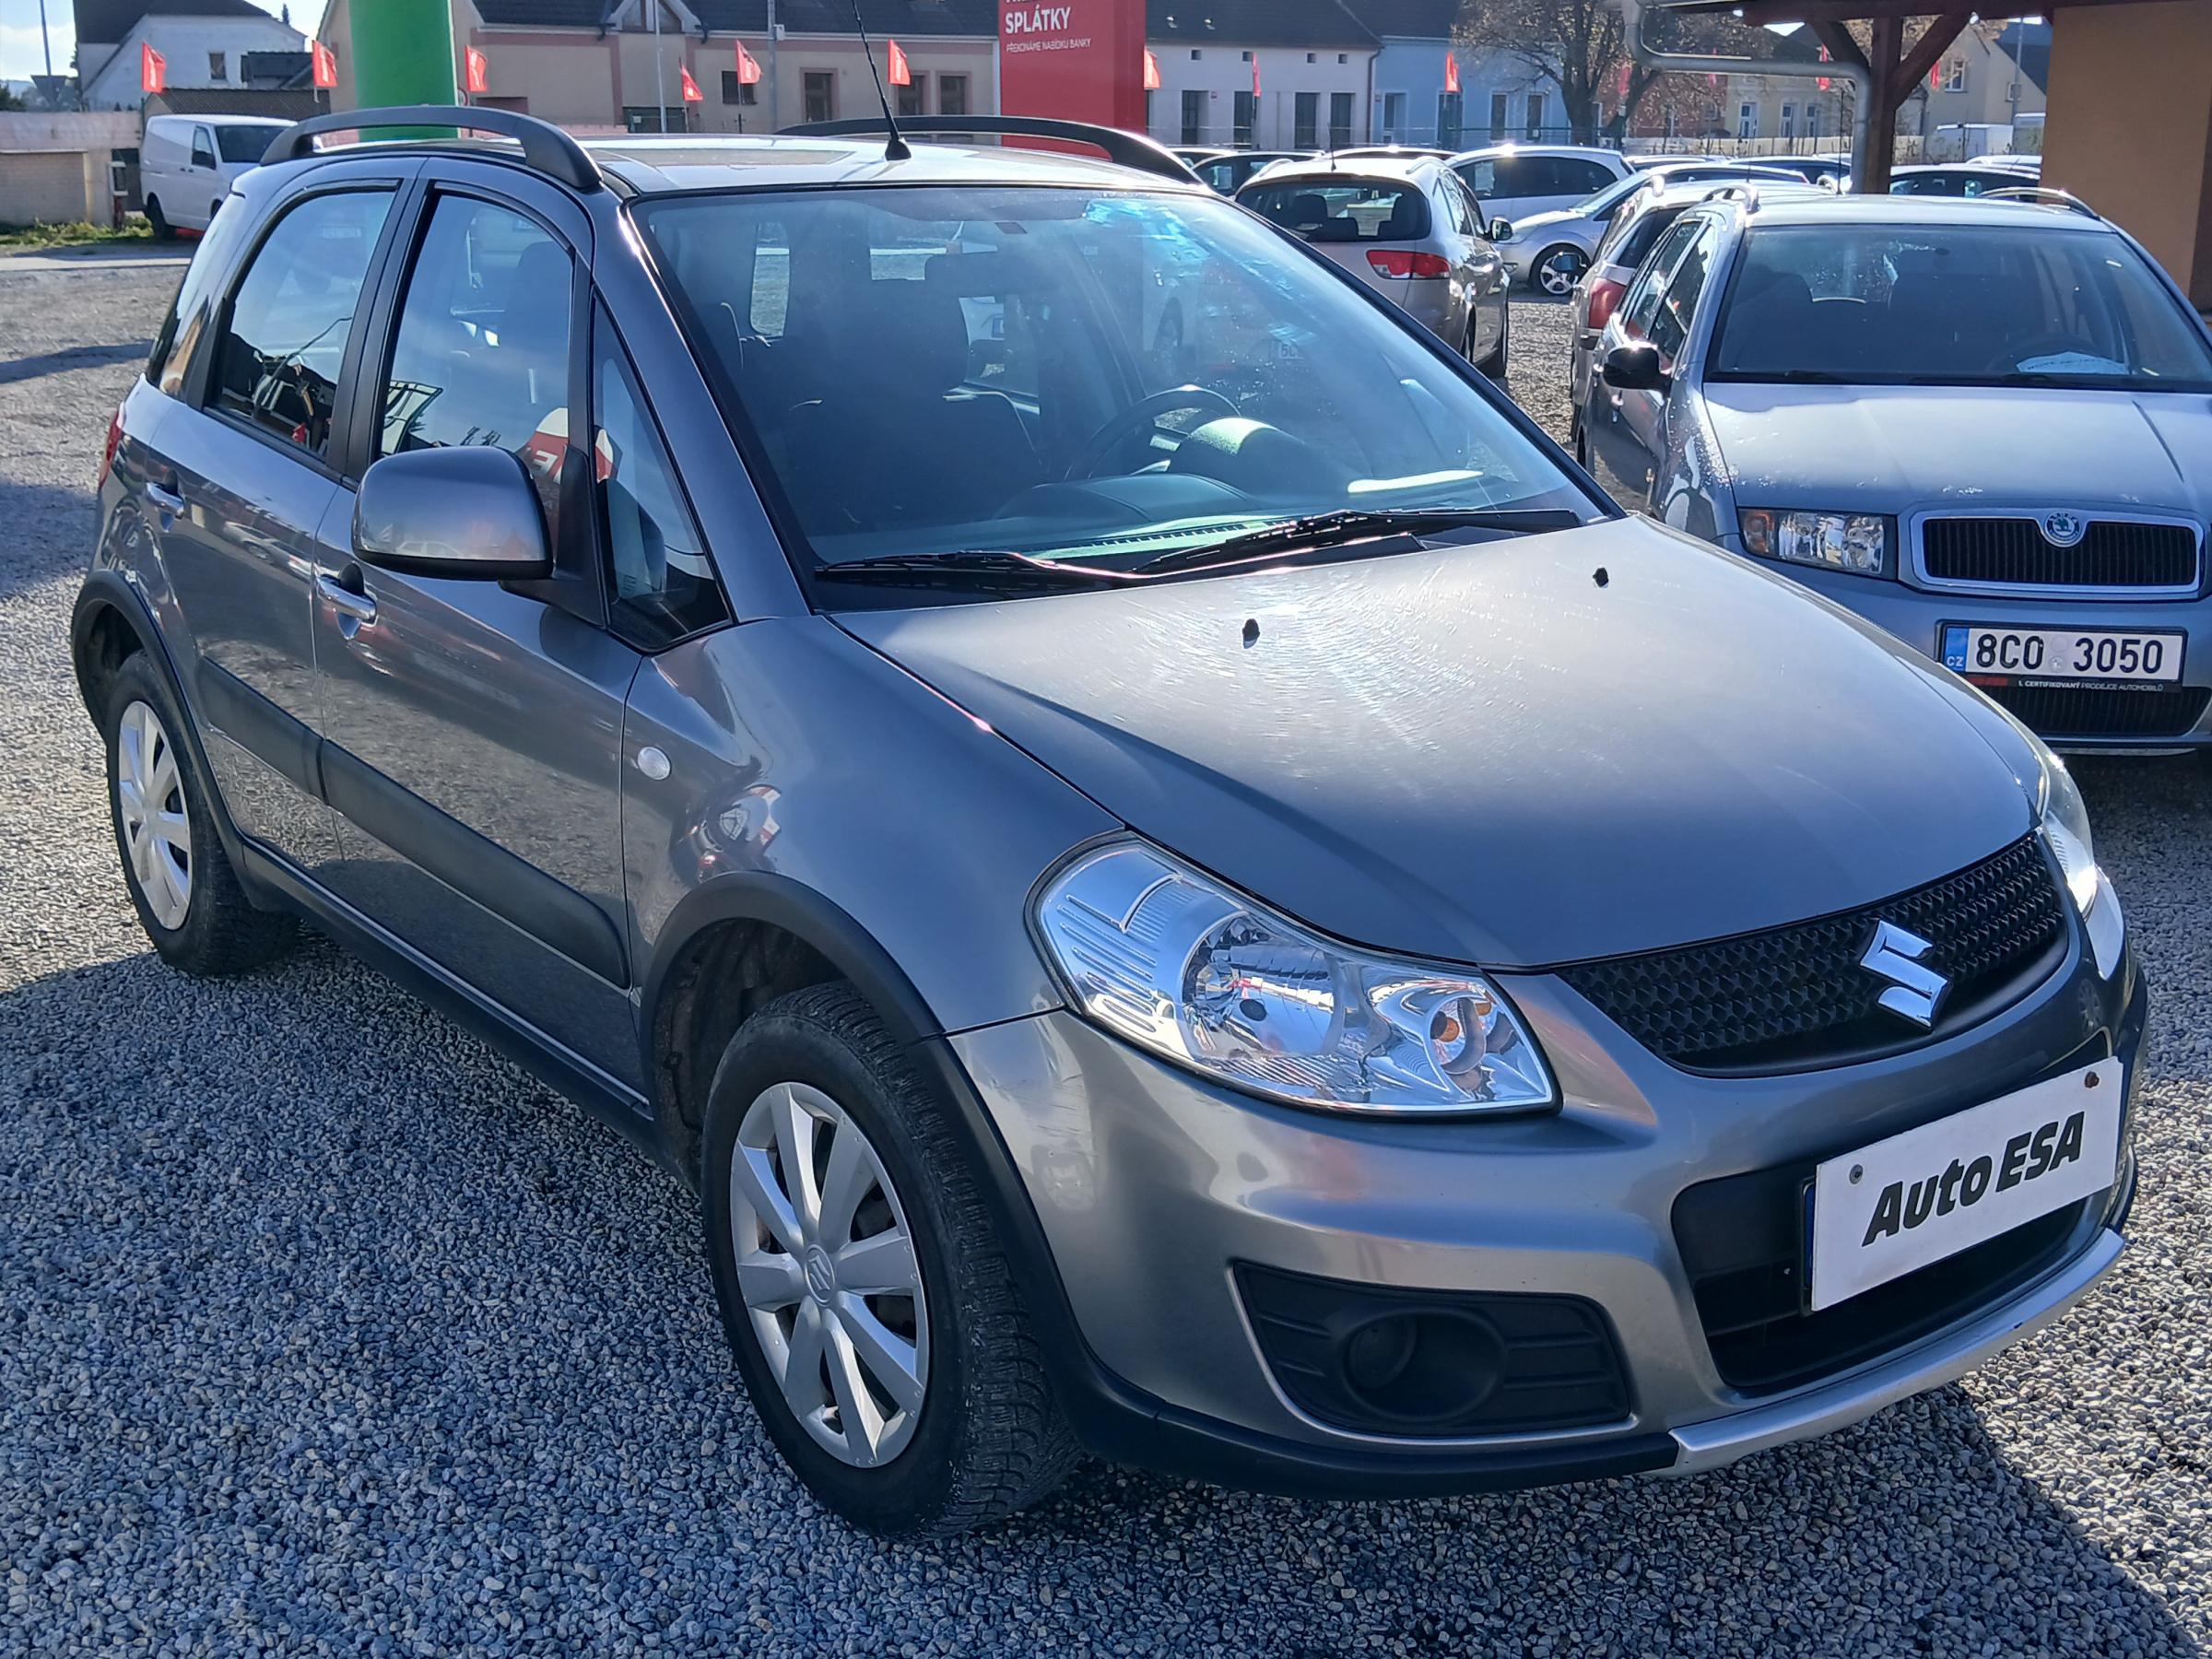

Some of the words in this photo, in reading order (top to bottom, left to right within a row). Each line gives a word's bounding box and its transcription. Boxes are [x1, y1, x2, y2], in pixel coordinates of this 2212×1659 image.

[1006, 4, 1071, 34] SPLÁTKY
[1070, 38, 1091, 49] BANKY
[1947, 655, 1964, 667] CZ
[2073, 637, 2164, 674] 3050
[1862, 1155, 1993, 1248] Auto
[1995, 1111, 2085, 1193] ESA
